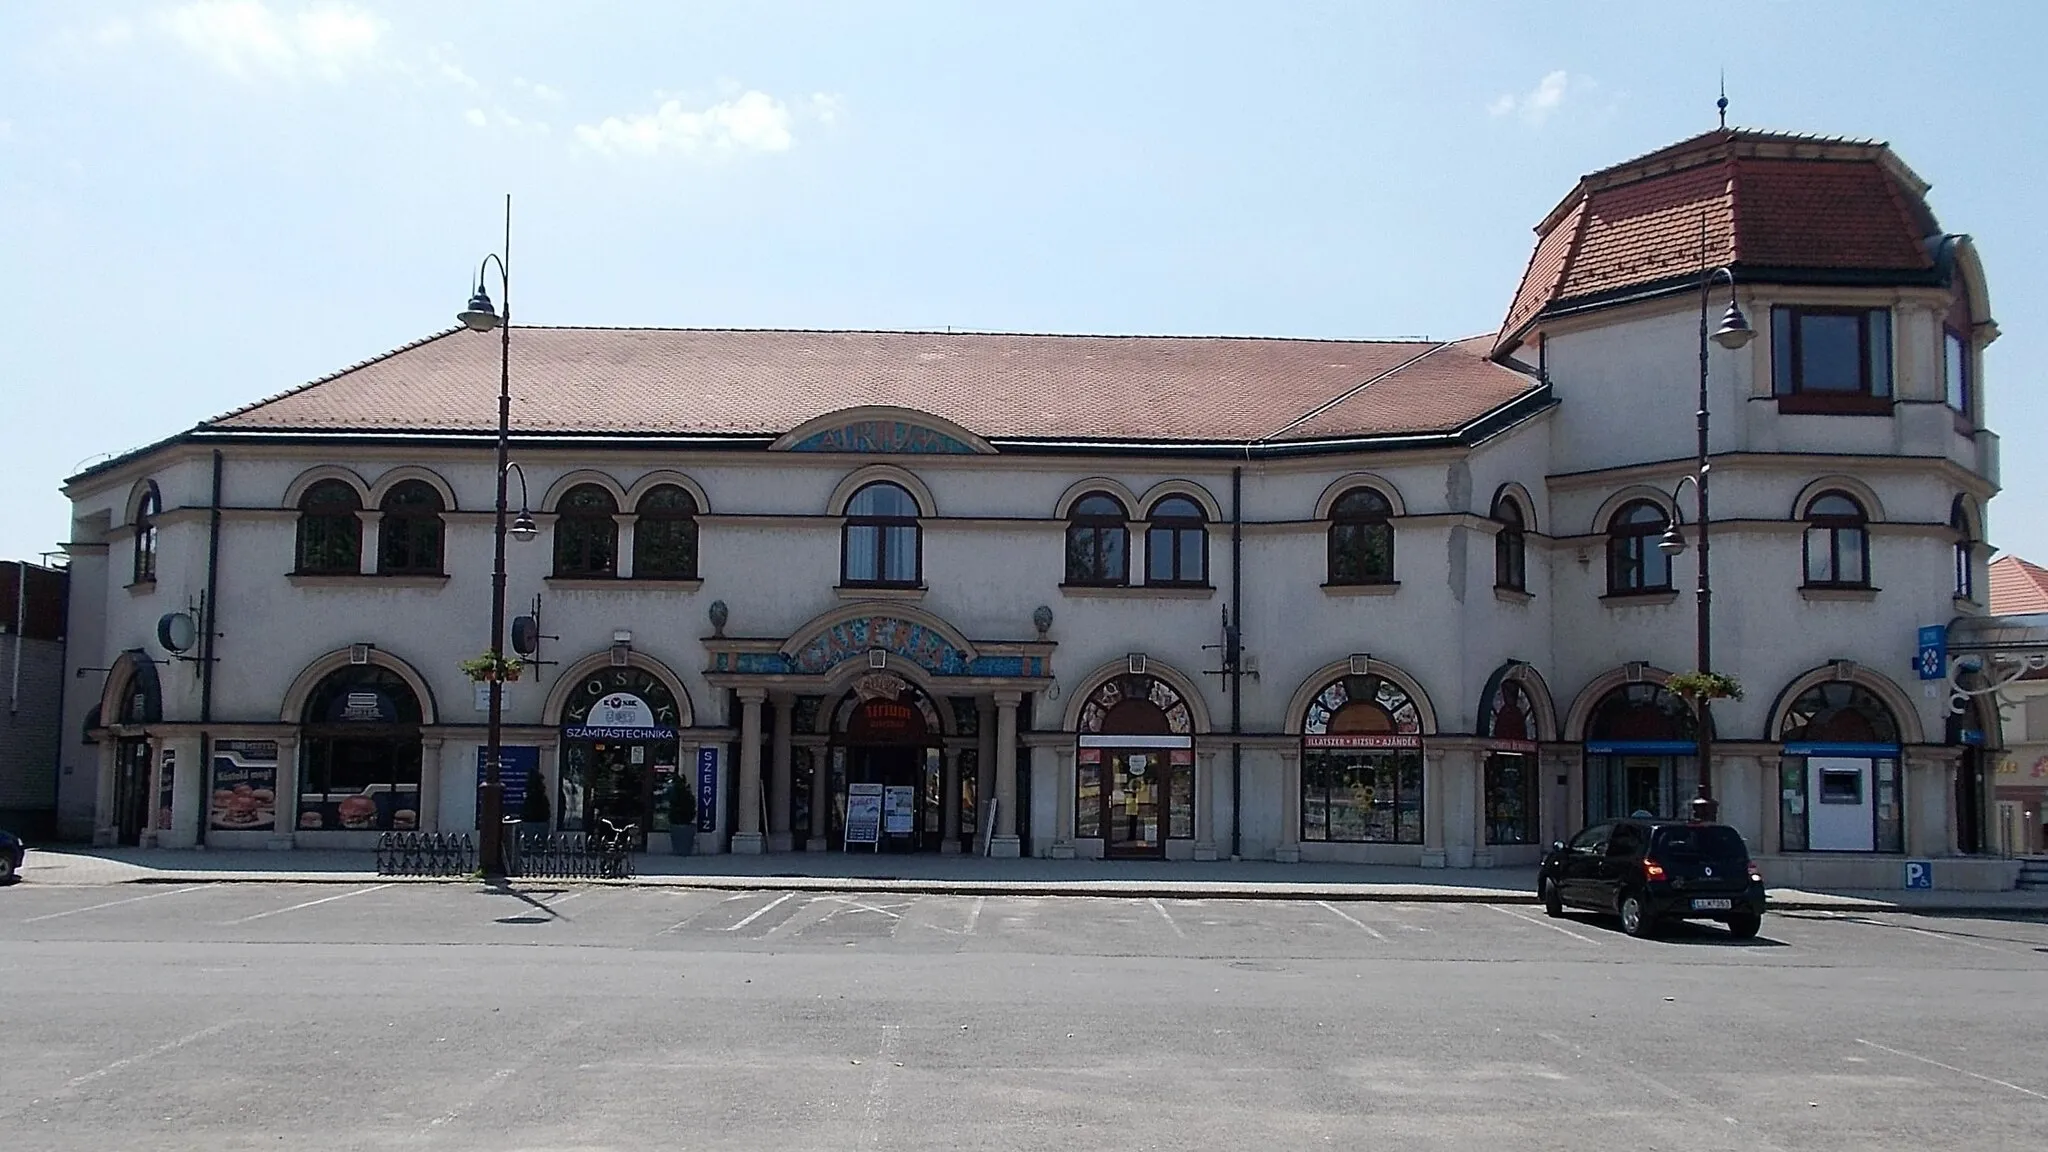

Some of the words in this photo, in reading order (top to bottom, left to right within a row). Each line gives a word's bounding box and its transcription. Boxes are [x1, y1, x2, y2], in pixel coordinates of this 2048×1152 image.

[566, 726, 674, 739] SZÁMÍTÁSTECHNIKA
[1307, 737, 1345, 747] ILLATSZER
[1382, 736, 1418, 747] AJÁNDÉK
[702, 751, 713, 830] SZERVIZ
[1906, 863, 1924, 886] P
